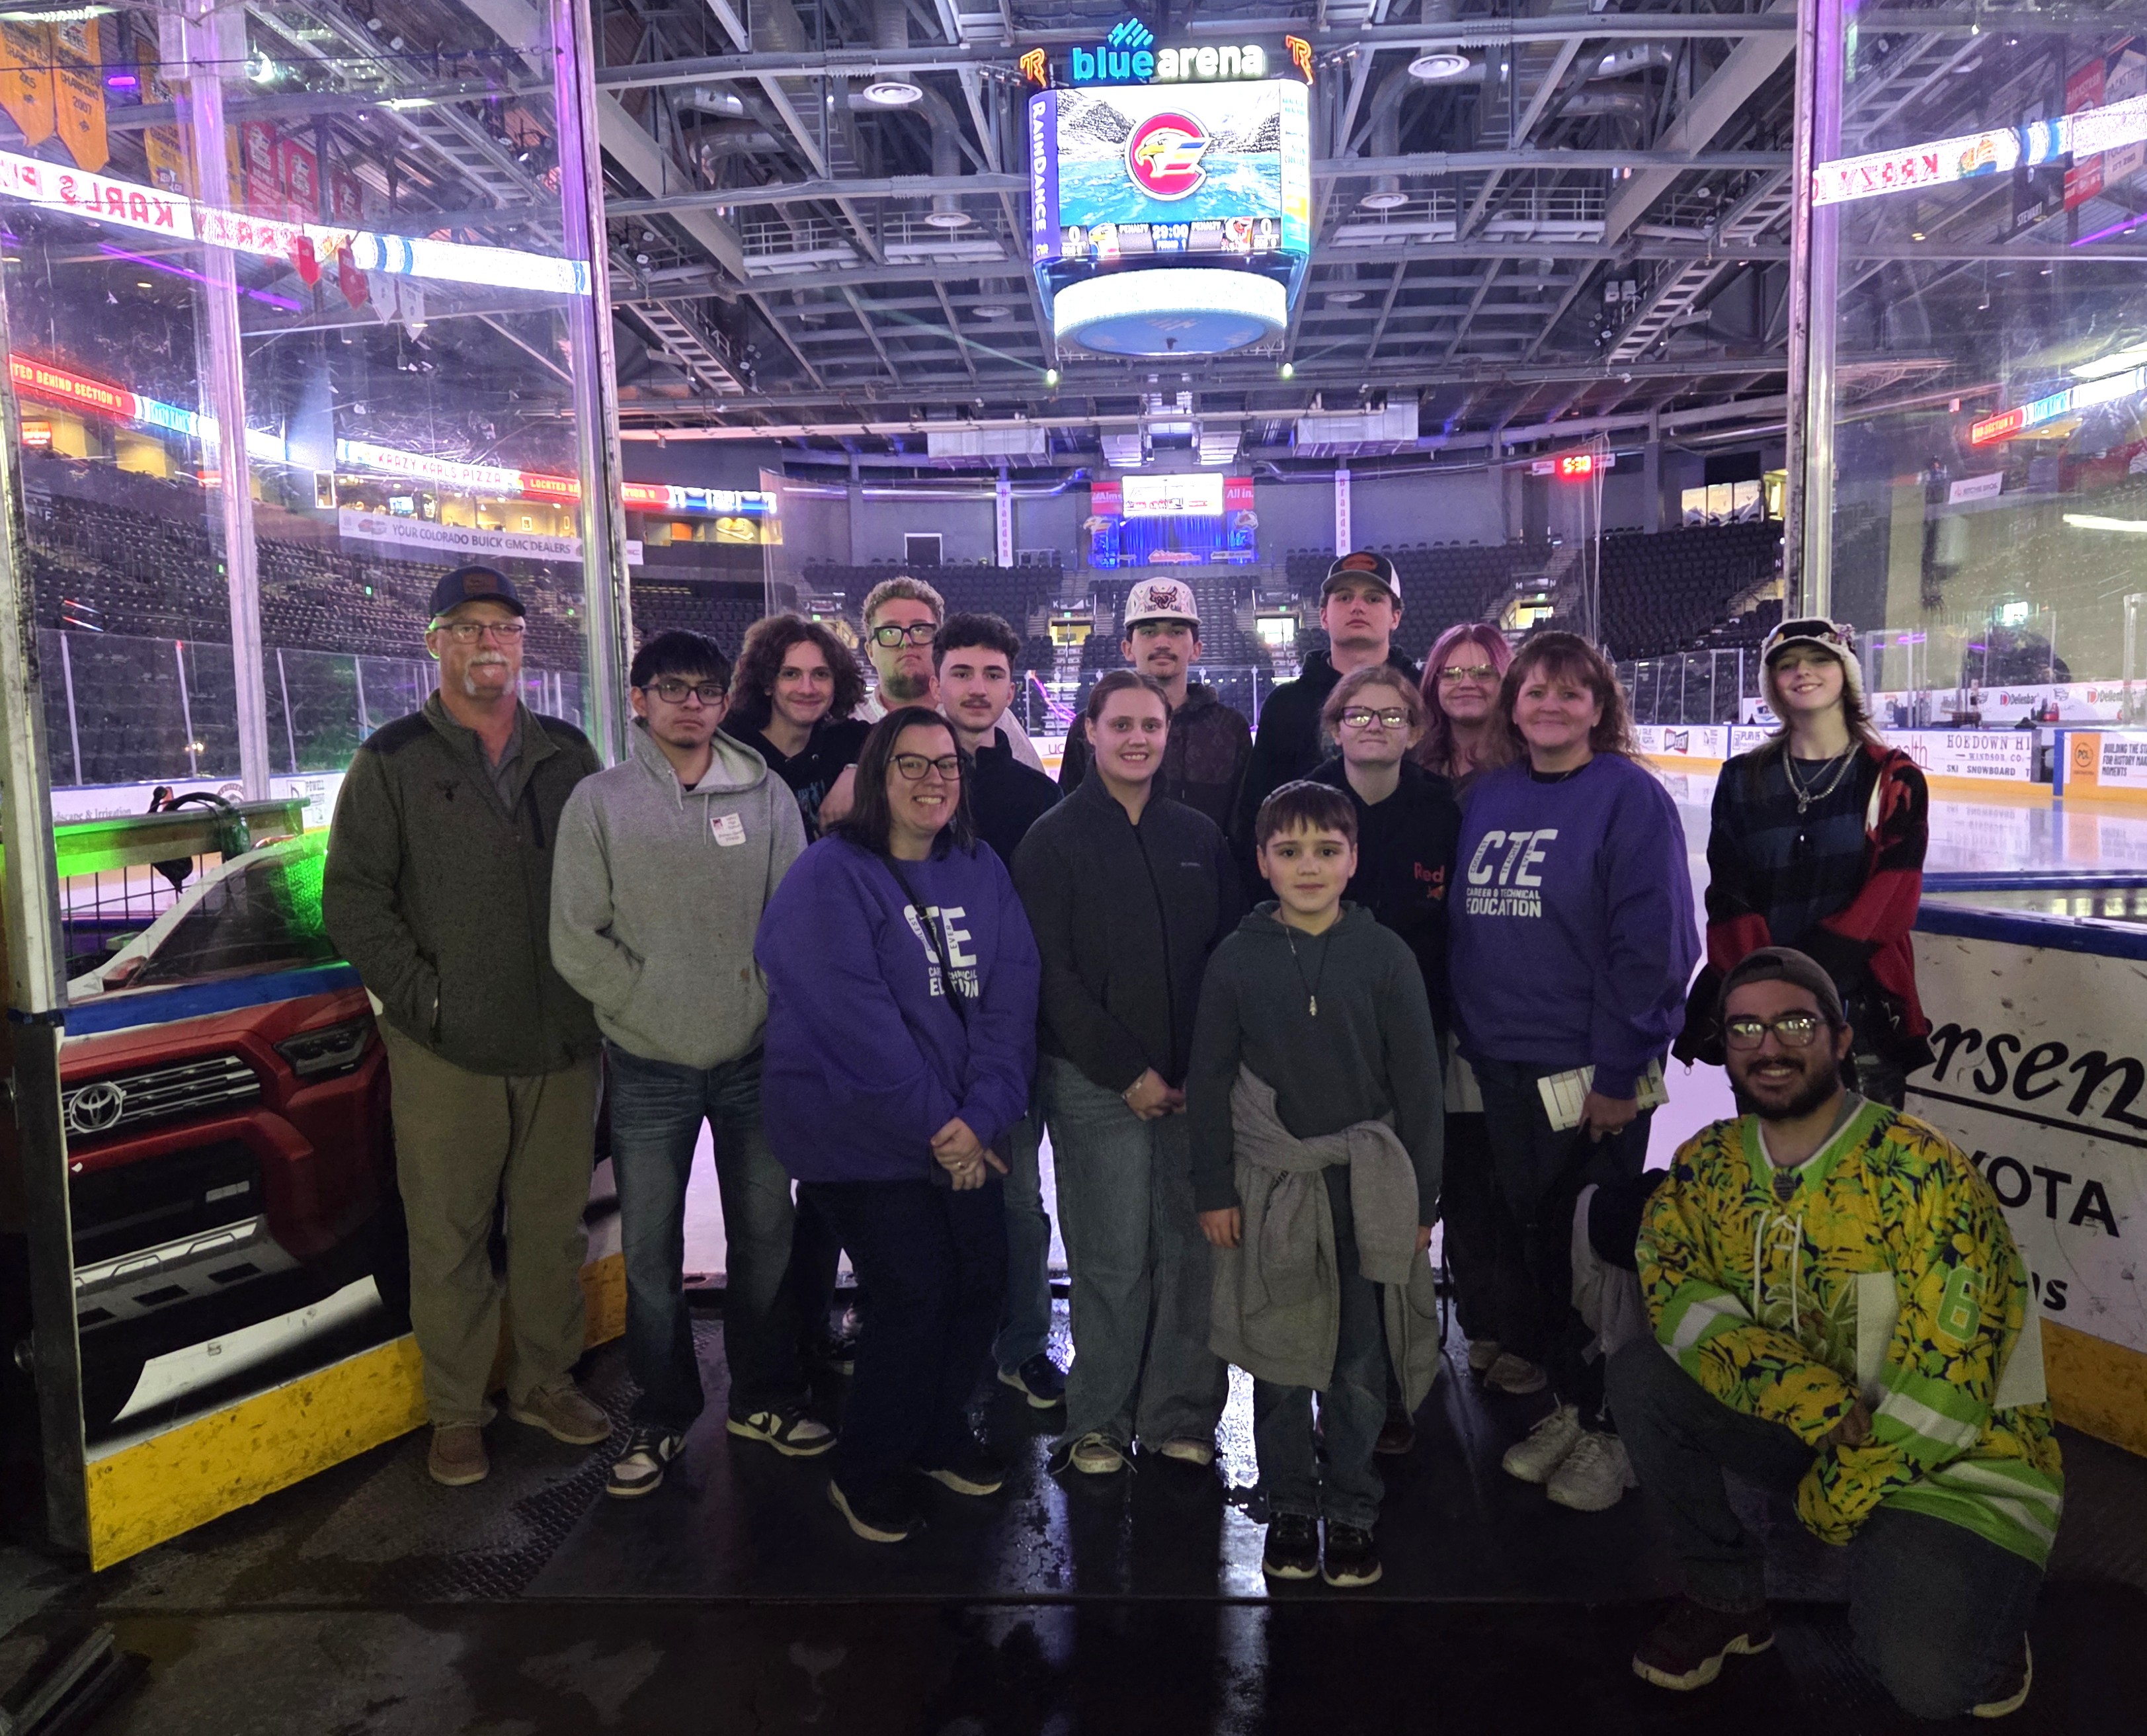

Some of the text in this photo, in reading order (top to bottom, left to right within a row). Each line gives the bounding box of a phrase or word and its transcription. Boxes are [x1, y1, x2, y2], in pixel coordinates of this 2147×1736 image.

[1073, 44, 1265, 79] blue arena
[73, 95, 92, 115] 2007
[1032, 101, 1047, 233] RAINDANCE
[2017, 201, 2043, 227] STEWART
[1068, 226, 1080, 243] 0
[1152, 224, 1189, 239] 29:00
[1260, 218, 1272, 235] 0
[13, 362, 33, 380] TED
[36, 372, 72, 392] BEHIND
[75, 382, 113, 405] SECTION
[378, 452, 417, 471] KRAZY
[423, 463, 457, 479] KARLS
[463, 468, 501, 483] PIZZA
[530, 477, 567, 491] LOCATED
[1562, 455, 1592, 474] 5:30
[1227, 489, 1240, 499] All
[392, 523, 571, 554] YOUR COLORADO BUICK GMC DEALERS
[1775, 559, 1781, 568] N
[1549, 579, 1557, 588] N
[1053, 599, 1091, 608] K L
[1259, 594, 1265, 602] L
[1947, 734, 2031, 751] HOEDOWN HI
[2103, 743, 2128, 754] BUILDING
[2128, 743, 2139, 755] THE
[1968, 752, 2005, 762] WINDSOR
[2102, 755, 2113, 765] FOR
[2114, 755, 2136, 766] HISTORY
[1947, 764, 1959, 773] SKI
[1966, 765, 2015, 776] SNOWBOARD
[2101, 766, 2127, 777] MOMENTS
[1467, 829, 1559, 888] CTE
[1413, 861, 1445, 884] Red
[1466, 887, 1492, 898] CAREER
[1500, 888, 1541, 900] TECHNICAL
[1465, 897, 1542, 918] EDUCATION
[946, 925, 957, 950] EVER
[1937, 1264, 1983, 1343] 6
